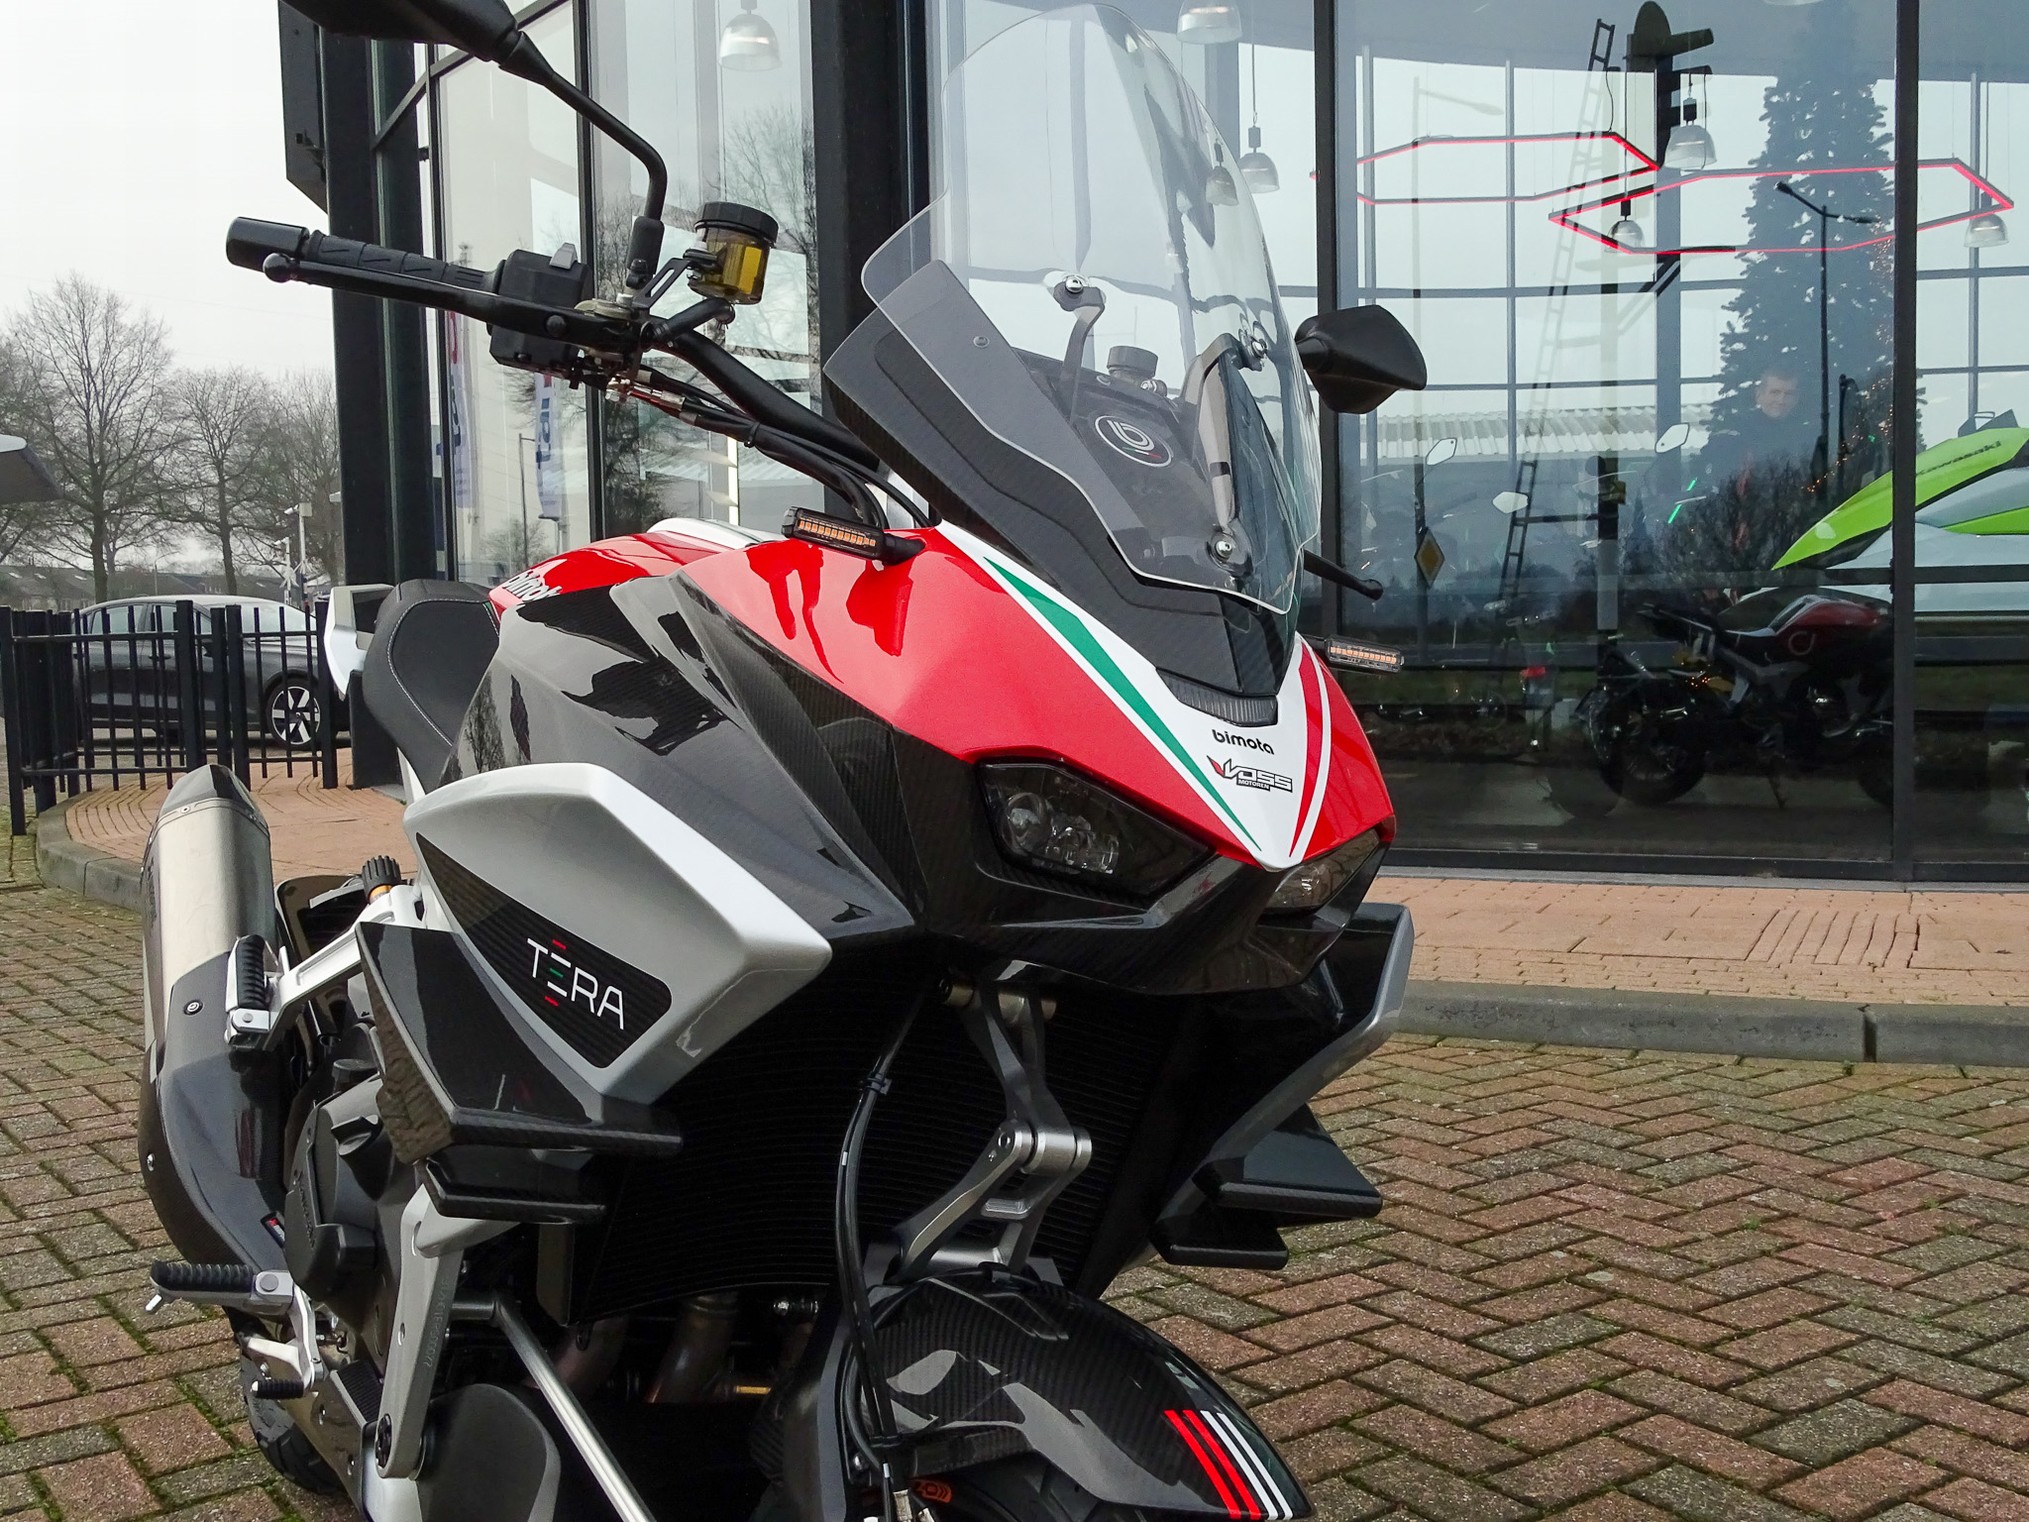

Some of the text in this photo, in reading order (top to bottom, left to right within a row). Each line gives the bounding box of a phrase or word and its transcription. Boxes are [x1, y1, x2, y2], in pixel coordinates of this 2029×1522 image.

[1212, 729, 1275, 755] bimota
[1207, 755, 1293, 793] VOSS
[1238, 779, 1270, 790] MOTOREN
[527, 938, 624, 1030] TERA
